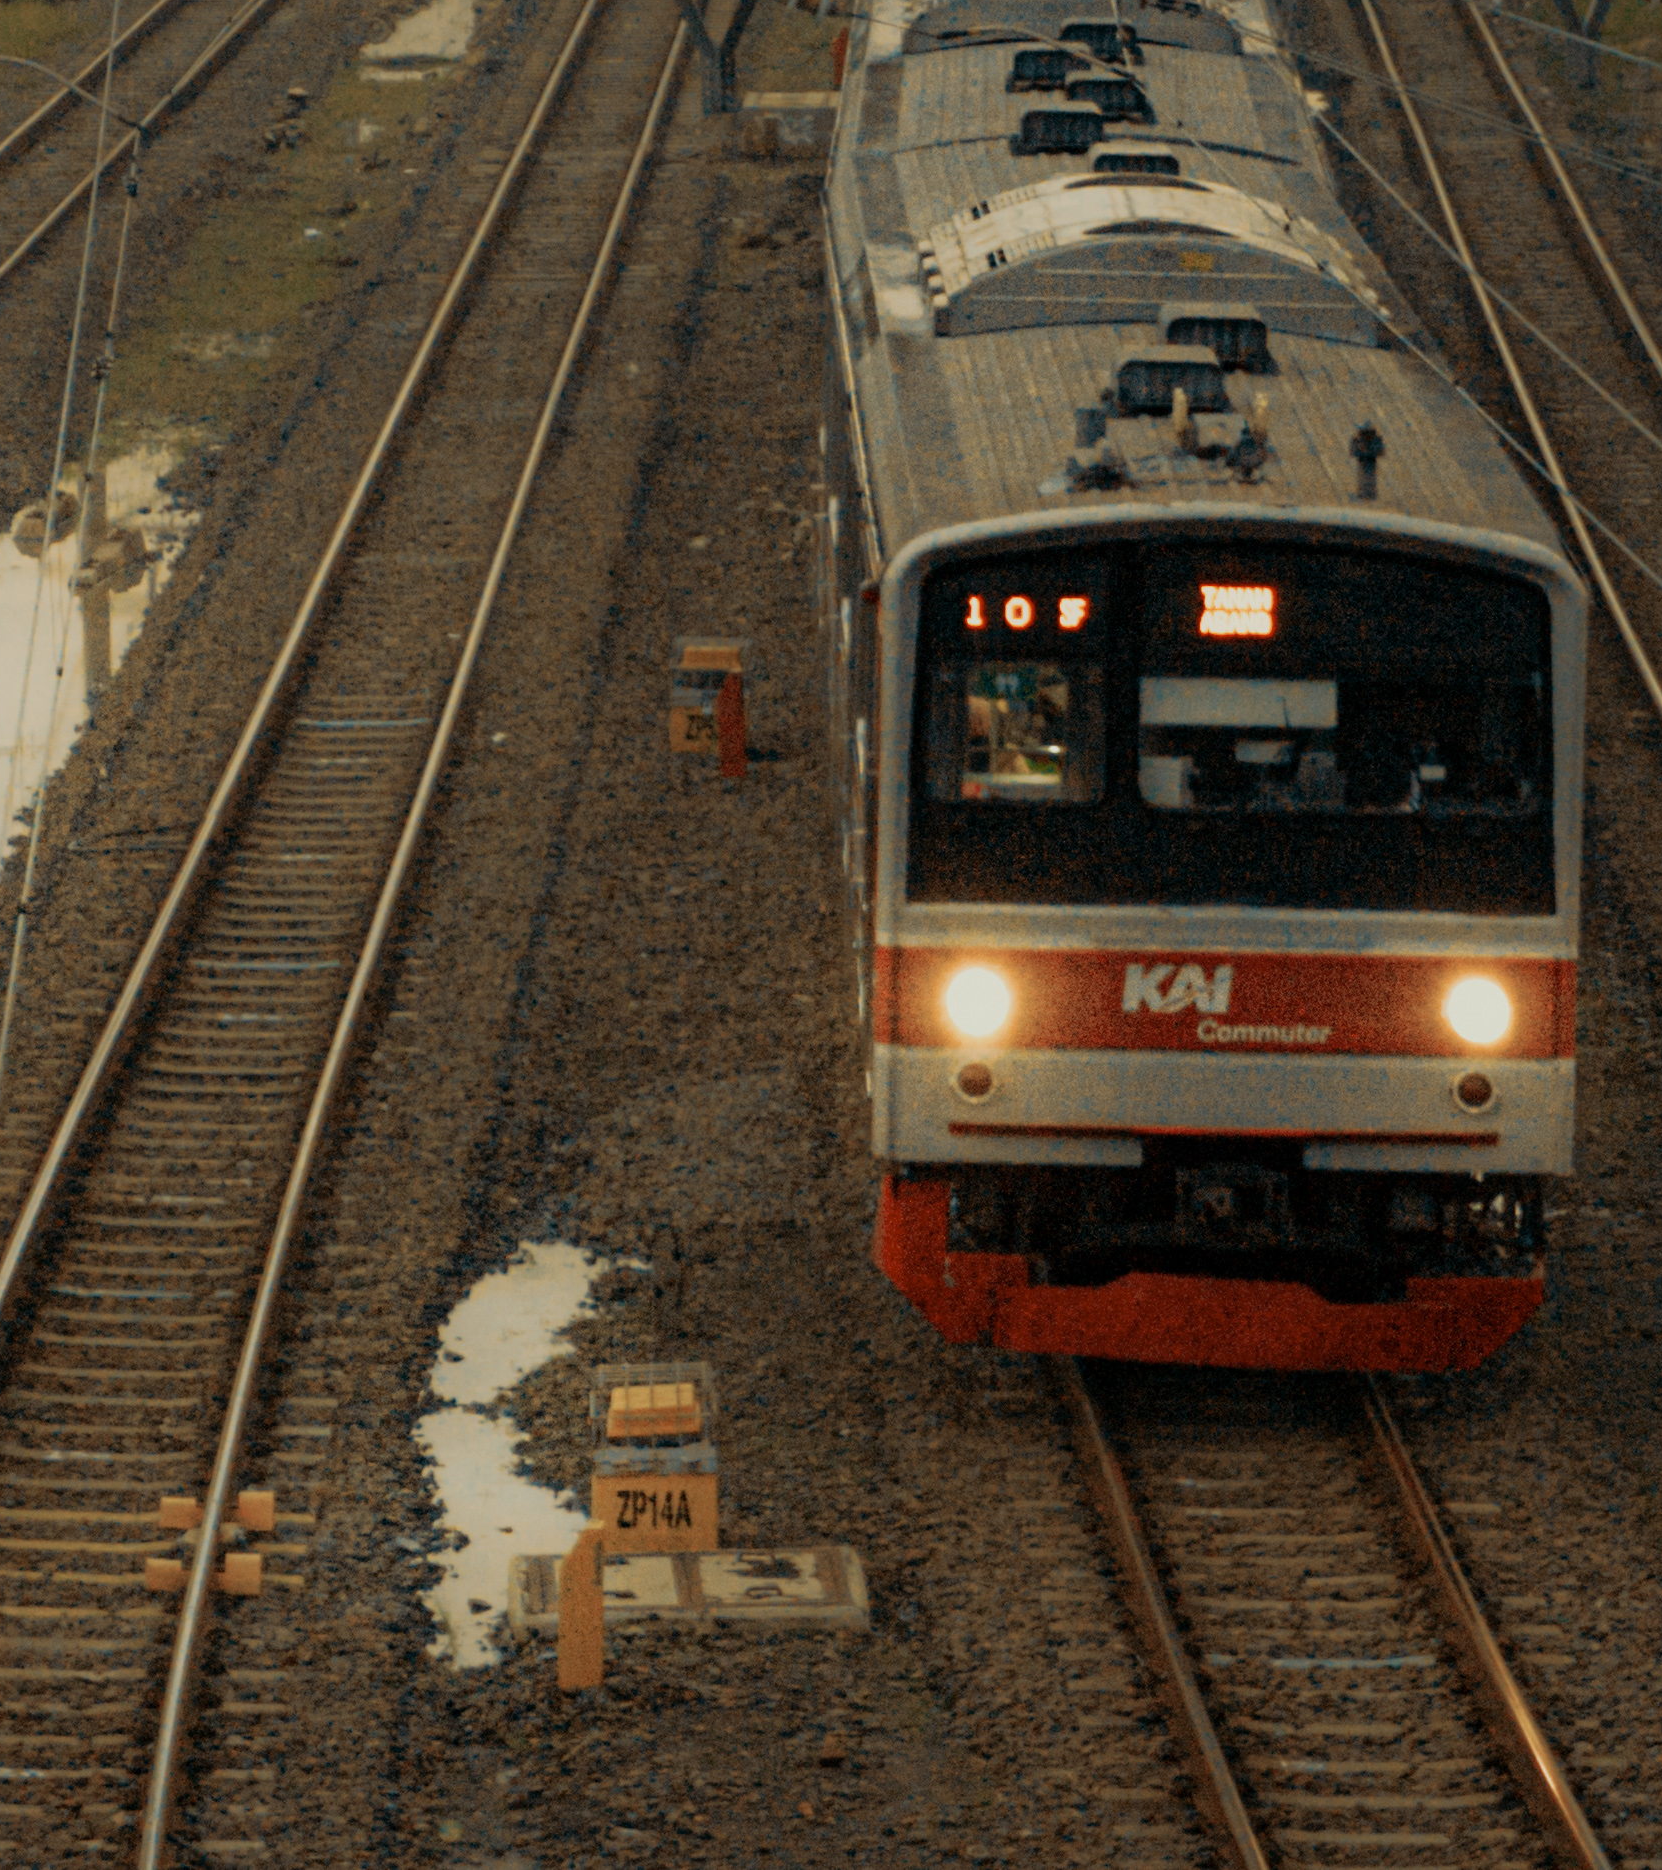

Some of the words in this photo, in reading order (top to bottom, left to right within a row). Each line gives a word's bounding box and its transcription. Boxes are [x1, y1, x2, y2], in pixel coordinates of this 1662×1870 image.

[1121, 963, 1233, 1014] KAI
[1197, 1019, 1334, 1045] Commuter
[616, 1489, 693, 1528] ZP14A
